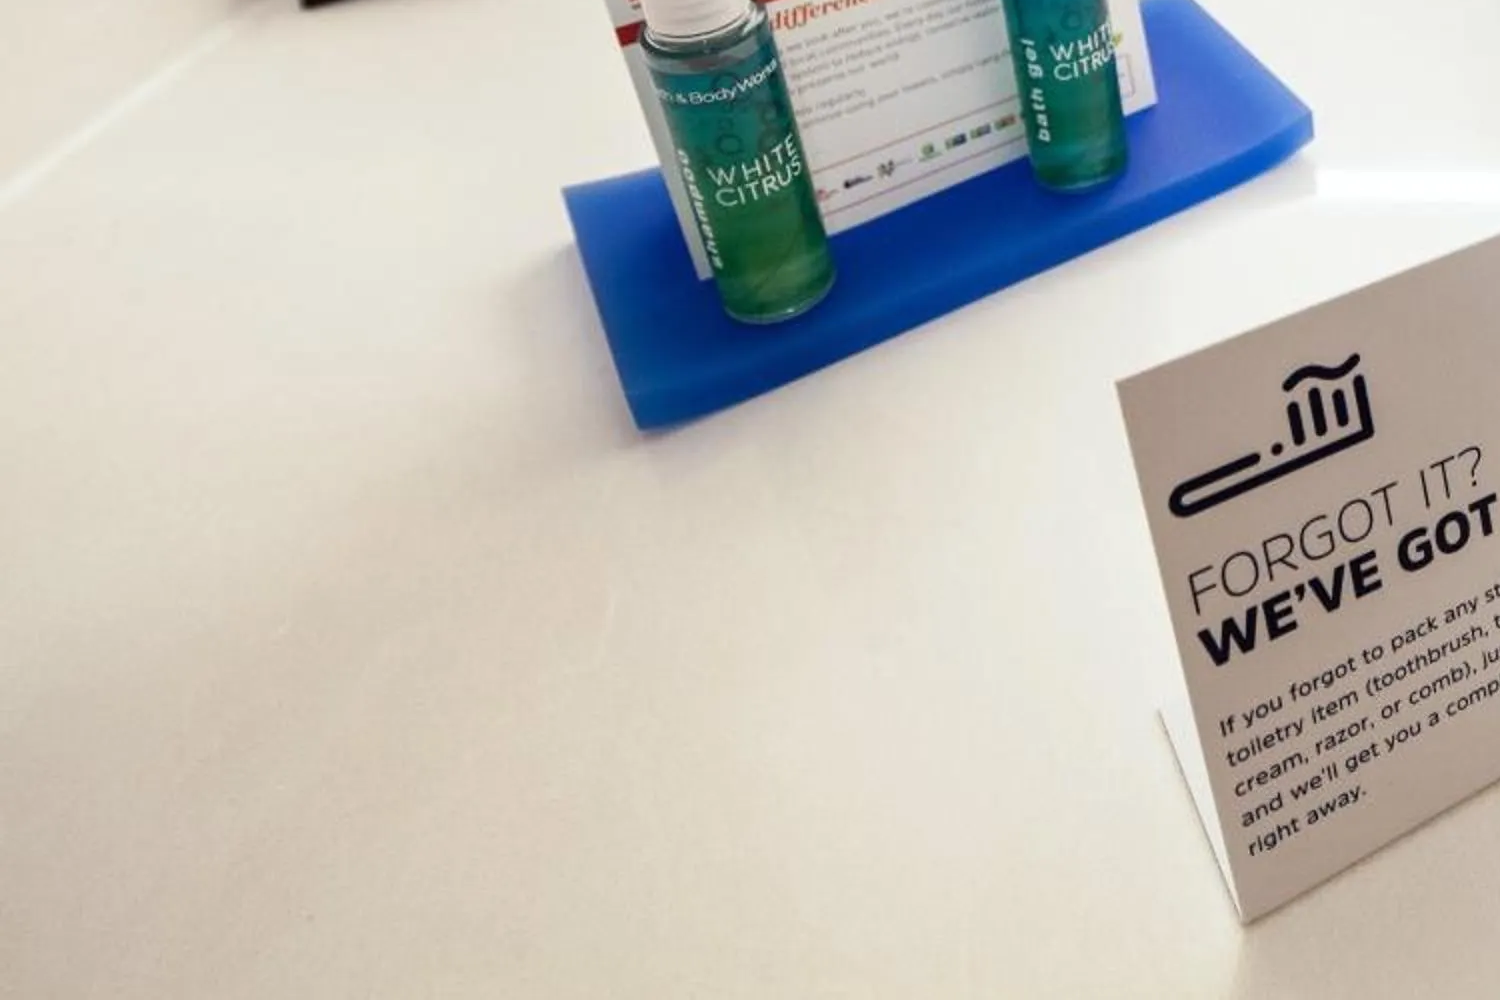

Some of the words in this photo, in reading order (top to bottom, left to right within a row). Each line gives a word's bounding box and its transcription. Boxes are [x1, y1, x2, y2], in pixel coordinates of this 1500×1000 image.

[1020, 37, 1045, 79] gel
[1030, 88, 1052, 143] bath
[705, 132, 799, 188] WHITE
[714, 154, 803, 208] CITRUS
[1187, 480, 1399, 617] FORGOT
[1419, 445, 1483, 510] IT?
[1396, 491, 1498, 574] GOT
[1219, 714, 1236, 738] If
[1241, 695, 1284, 729] you
[1288, 656, 1358, 703] forgot
[1361, 644, 1385, 665] to
[1390, 615, 1439, 655] pack
[1443, 596, 1479, 625] any
[1225, 717, 1304, 768] toiletry
[1311, 690, 1359, 725] item
[1365, 625, 1489, 697] (toothbrush,
[1234, 752, 1310, 798] cream,
[1315, 716, 1375, 756] razor,
[1380, 698, 1403, 721] or
[1408, 660, 1478, 706] comb),
[1241, 791, 1284, 828] and
[1344, 741, 1381, 774] get
[1383, 720, 1422, 754] you
[1427, 711, 1441, 728] a
[1247, 817, 1301, 857] right
[1306, 785, 1367, 826] away.
